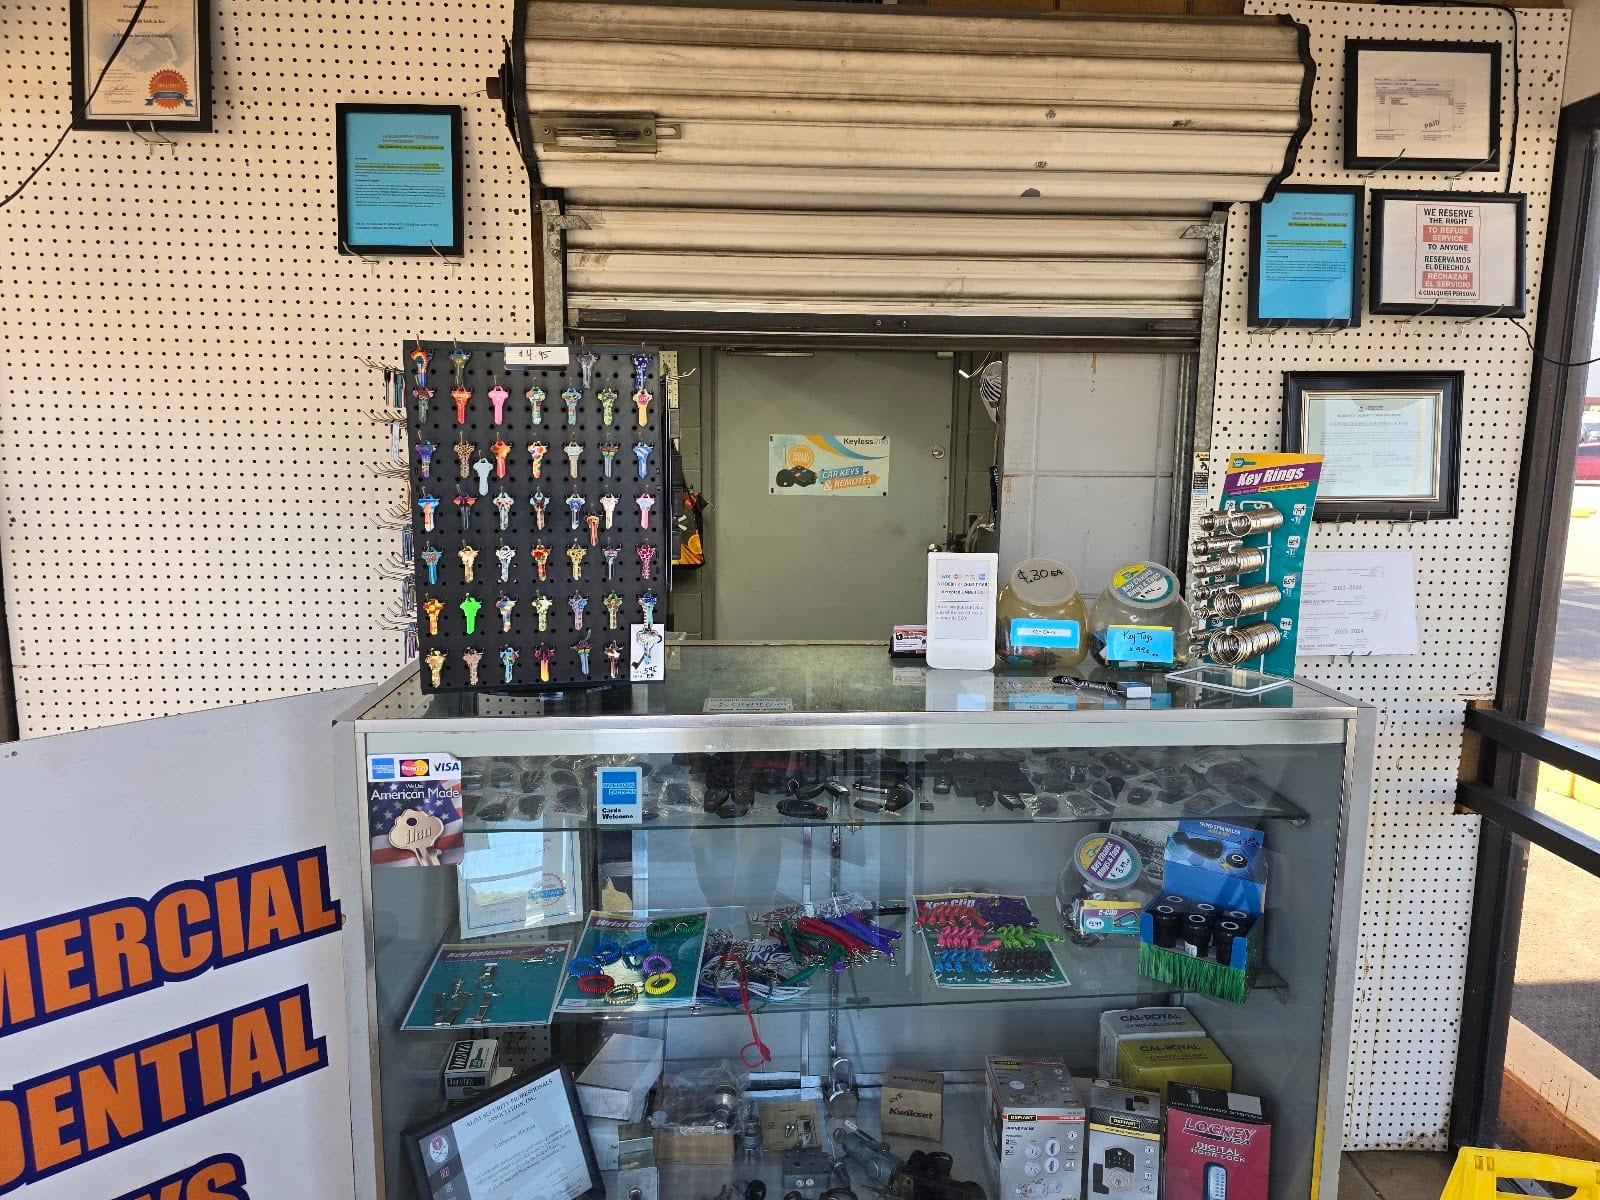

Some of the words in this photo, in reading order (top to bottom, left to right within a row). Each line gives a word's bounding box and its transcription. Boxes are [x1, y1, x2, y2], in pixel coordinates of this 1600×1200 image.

[1424, 119, 1440, 129] PAID
[1423, 207, 1436, 216] WE
[1438, 208, 1474, 218] RESERVE
[1428, 226, 1438, 234] TO
[1440, 226, 1470, 234] REFUSE
[1432, 234, 1464, 242] SERVICE
[1439, 244, 1469, 252] ANYONE
[1424, 256, 1471, 264] RESERVAMOS
[1427, 272, 1468, 280] RECHAZAR
[1425, 280, 1434, 288] EL
[1436, 280, 1471, 288] SERVICIO
[822, 469, 837, 479] CAR
[839, 466, 860, 477] KEYS
[1236, 472, 1263, 487] Key
[1264, 467, 1305, 484] Rings
[823, 480, 833, 492] &
[834, 476, 873, 488] REMOTES
[1121, 630, 1136, 644] Key
[1137, 632, 1152, 644] Tags
[434, 762, 460, 772] VISA
[370, 789, 425, 801] American
[428, 787, 460, 798] Made
[596, 919, 627, 928] Wrist
[1120, 1012, 1182, 1022] CAL-ROYAL
[482, 1101, 510, 1119] SECURITY
[510, 1078, 553, 1104] PROFESSIONALS
[889, 1107, 934, 1120] Kwikset
[1184, 1117, 1257, 1141] LOCKEY
[1195, 1142, 1240, 1156] DIGITAL
[1190, 1147, 1218, 1158] DOOR
[1220, 1154, 1246, 1163] LOCK
